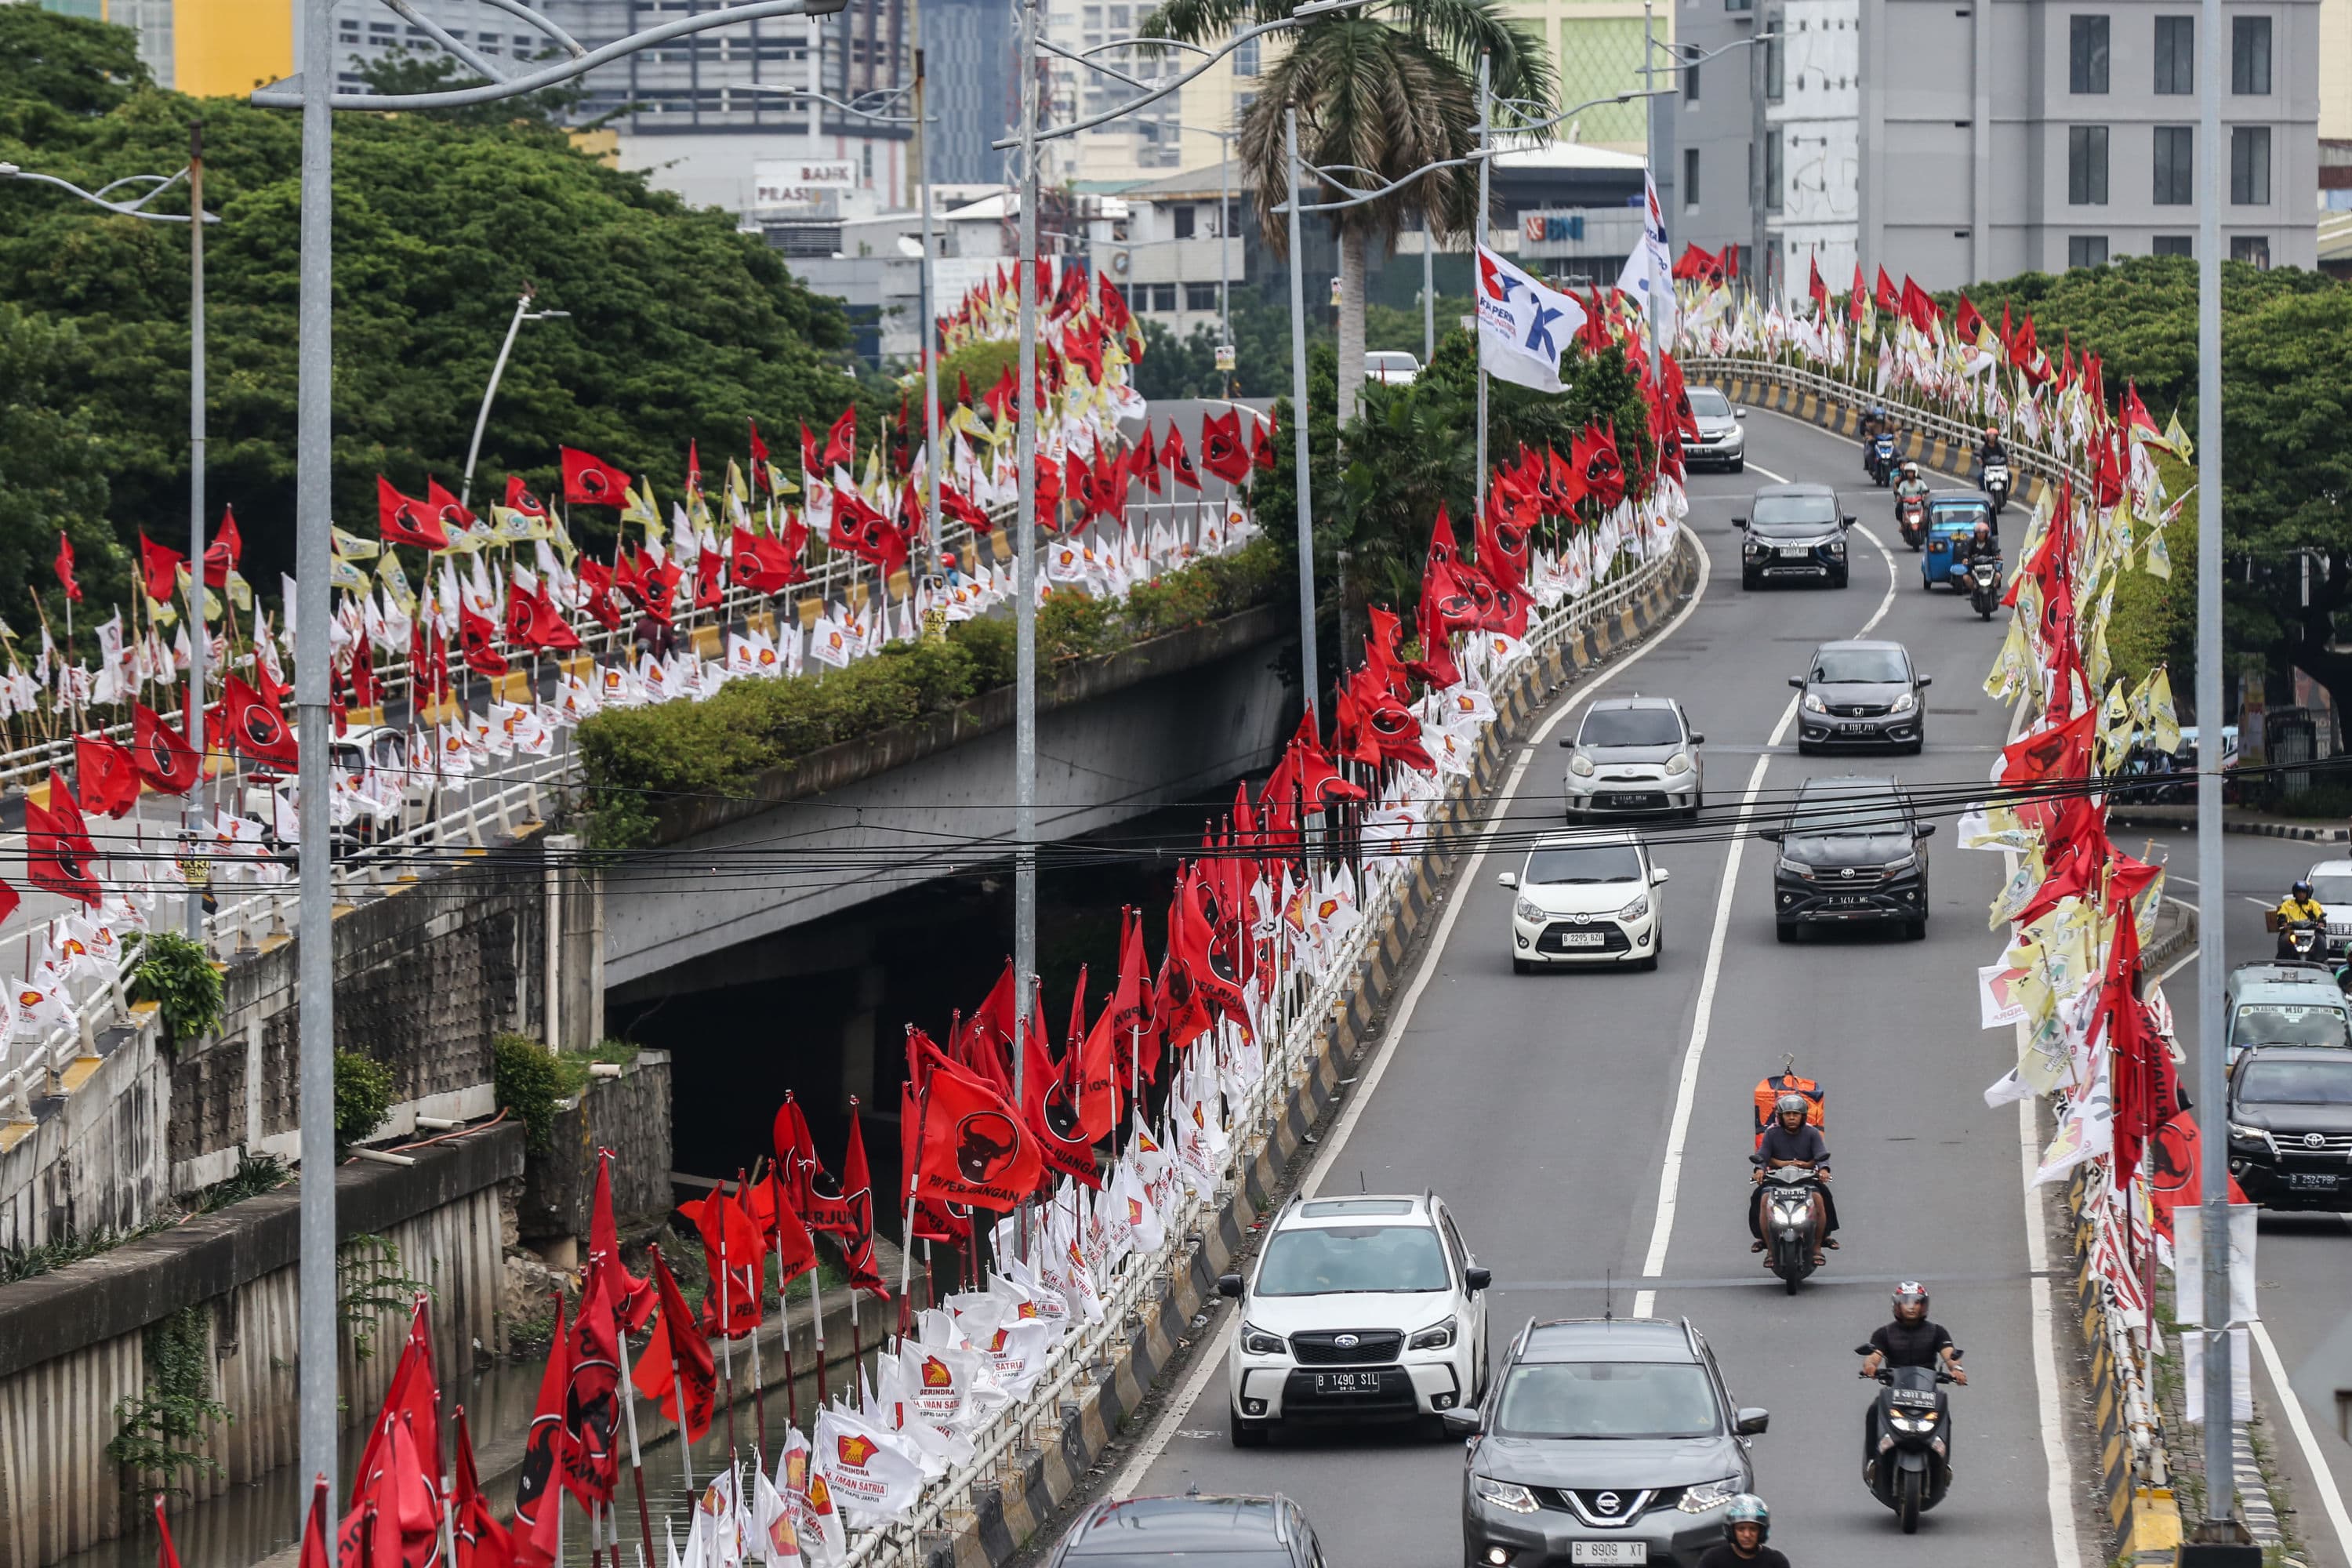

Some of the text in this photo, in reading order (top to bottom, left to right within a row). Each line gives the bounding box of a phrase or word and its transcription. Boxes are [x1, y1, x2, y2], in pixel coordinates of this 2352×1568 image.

[802, 166, 848, 181] BANK
[1546, 216, 1584, 240] BNI
[1563, 934, 1568, 942] B
[2292, 1175, 2297, 1184] B
[995, 1360, 1024, 1371] SATRIA
[1318, 1373, 1377, 1386] B 1490 SIL
[924, 1399, 943, 1410] IMAN
[837, 1463, 869, 1478] GERINDRA
[824, 1469, 886, 1495] H. IMAN SATRIA
[1575, 1543, 1644, 1557] B 8909 XT
